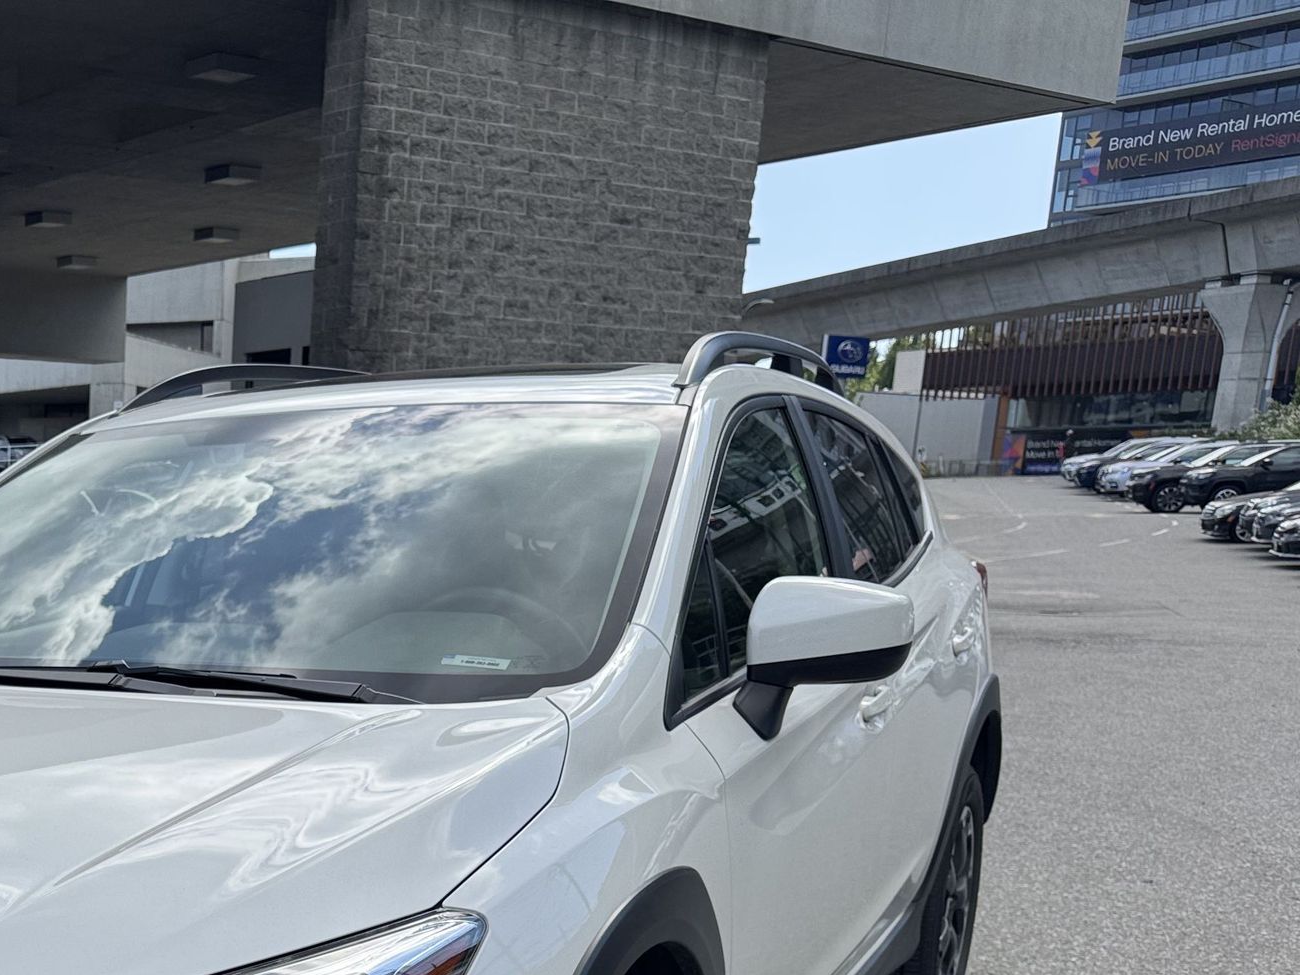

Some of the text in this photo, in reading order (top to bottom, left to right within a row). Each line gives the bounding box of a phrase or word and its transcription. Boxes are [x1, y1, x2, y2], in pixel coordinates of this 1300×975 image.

[1108, 130, 1155, 152] Brand
[1158, 128, 1194, 145] New
[1197, 113, 1250, 138] Rental
[1106, 150, 1170, 171] MOVE-IN
[1174, 141, 1225, 161] TODAY
[830, 364, 866, 375] SUBARU
